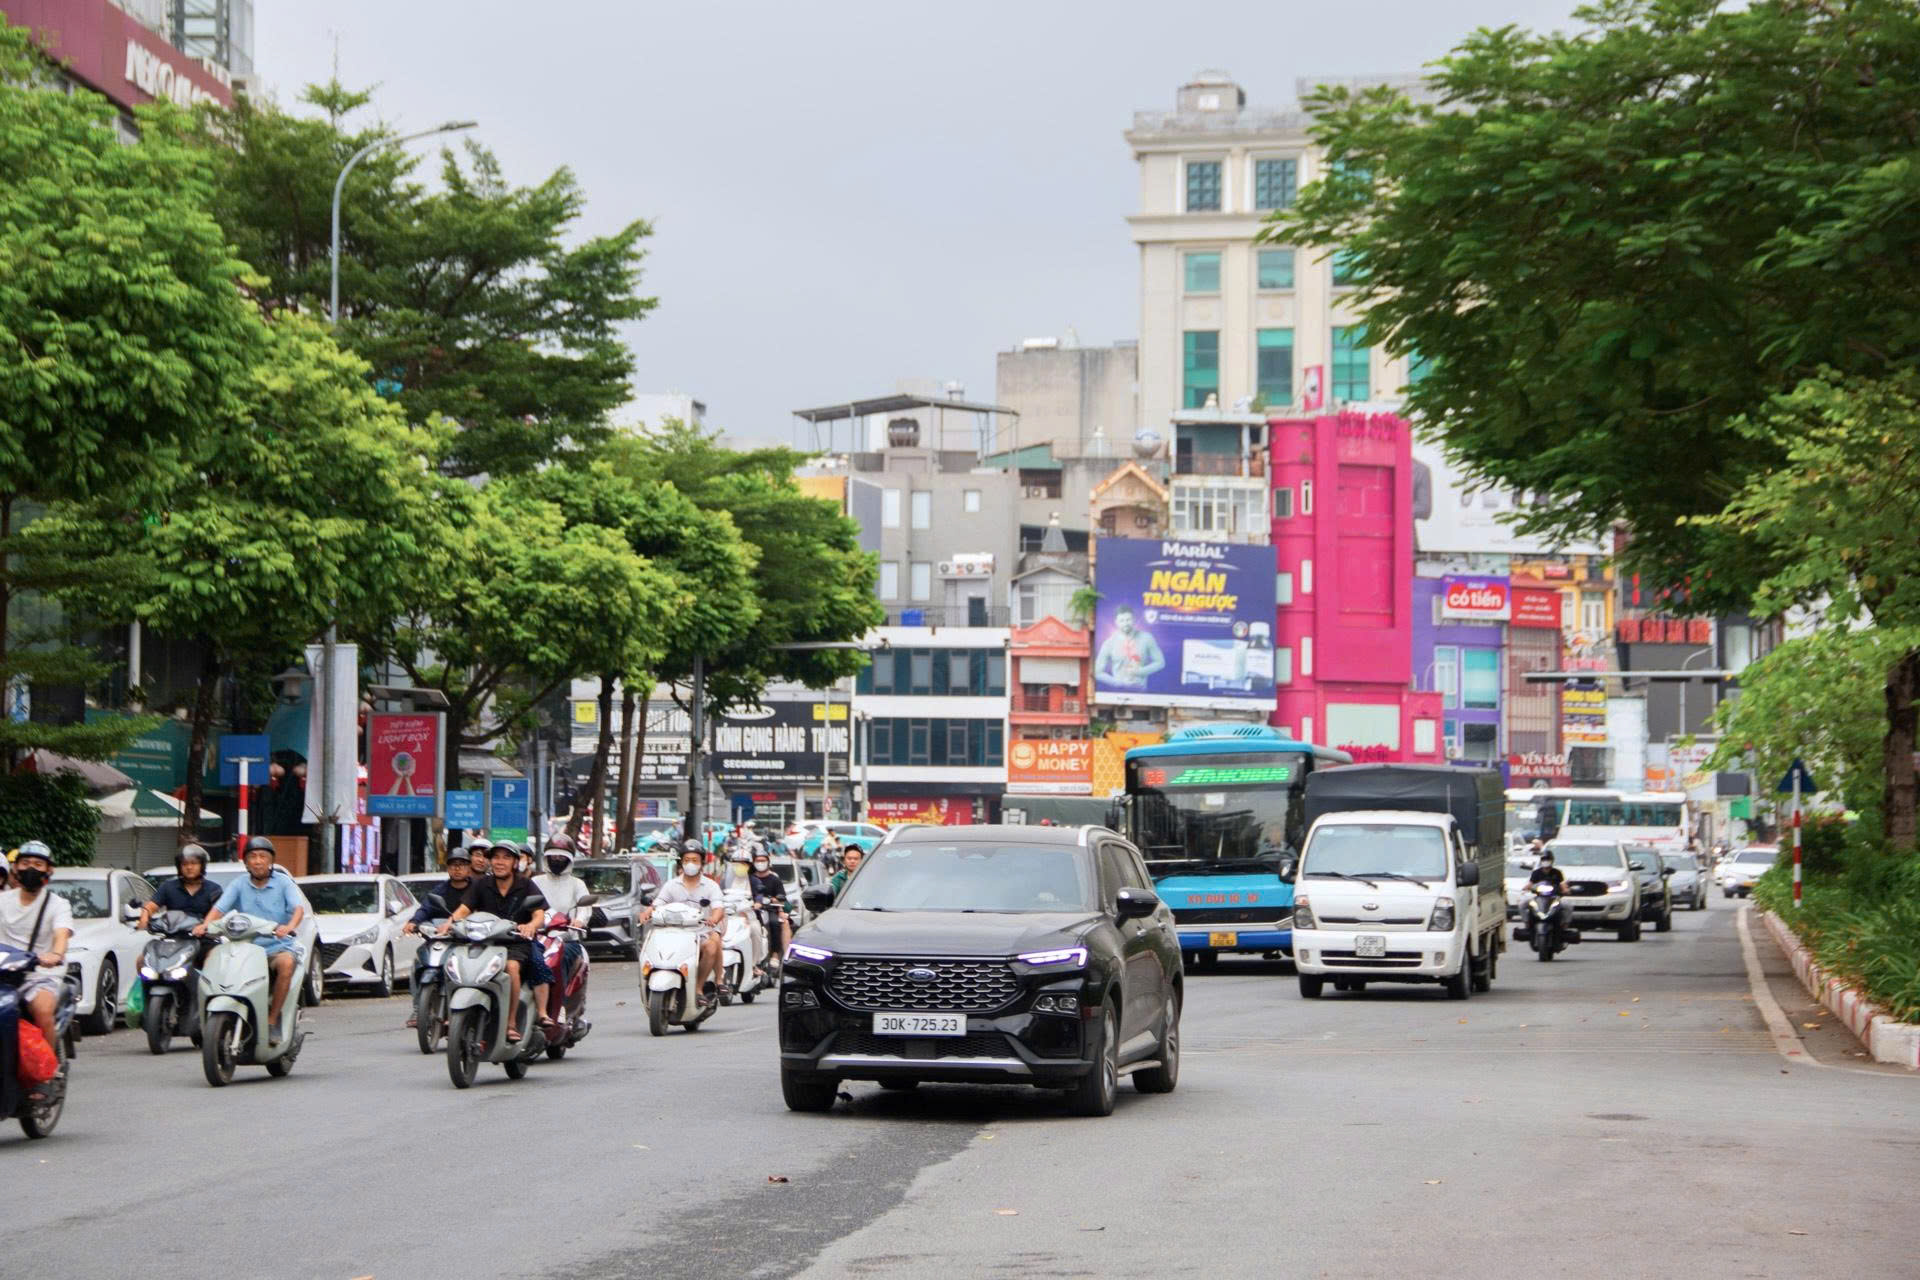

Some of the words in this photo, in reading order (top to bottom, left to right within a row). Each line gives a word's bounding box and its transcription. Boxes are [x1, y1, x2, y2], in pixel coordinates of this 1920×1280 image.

[1150, 568, 1227, 592] NGĂN
[1449, 591, 1470, 606] có
[715, 722, 742, 752] KÍNH
[743, 727, 773, 757] GỌNG
[774, 722, 806, 752] HÀNG
[1037, 744, 1089, 755] HAPPY
[723, 760, 786, 769] SECONDHAND
[1037, 758, 1089, 771] MONEY
[504, 783, 516, 798] P
[881, 1017, 958, 1031] 30K-725.23
